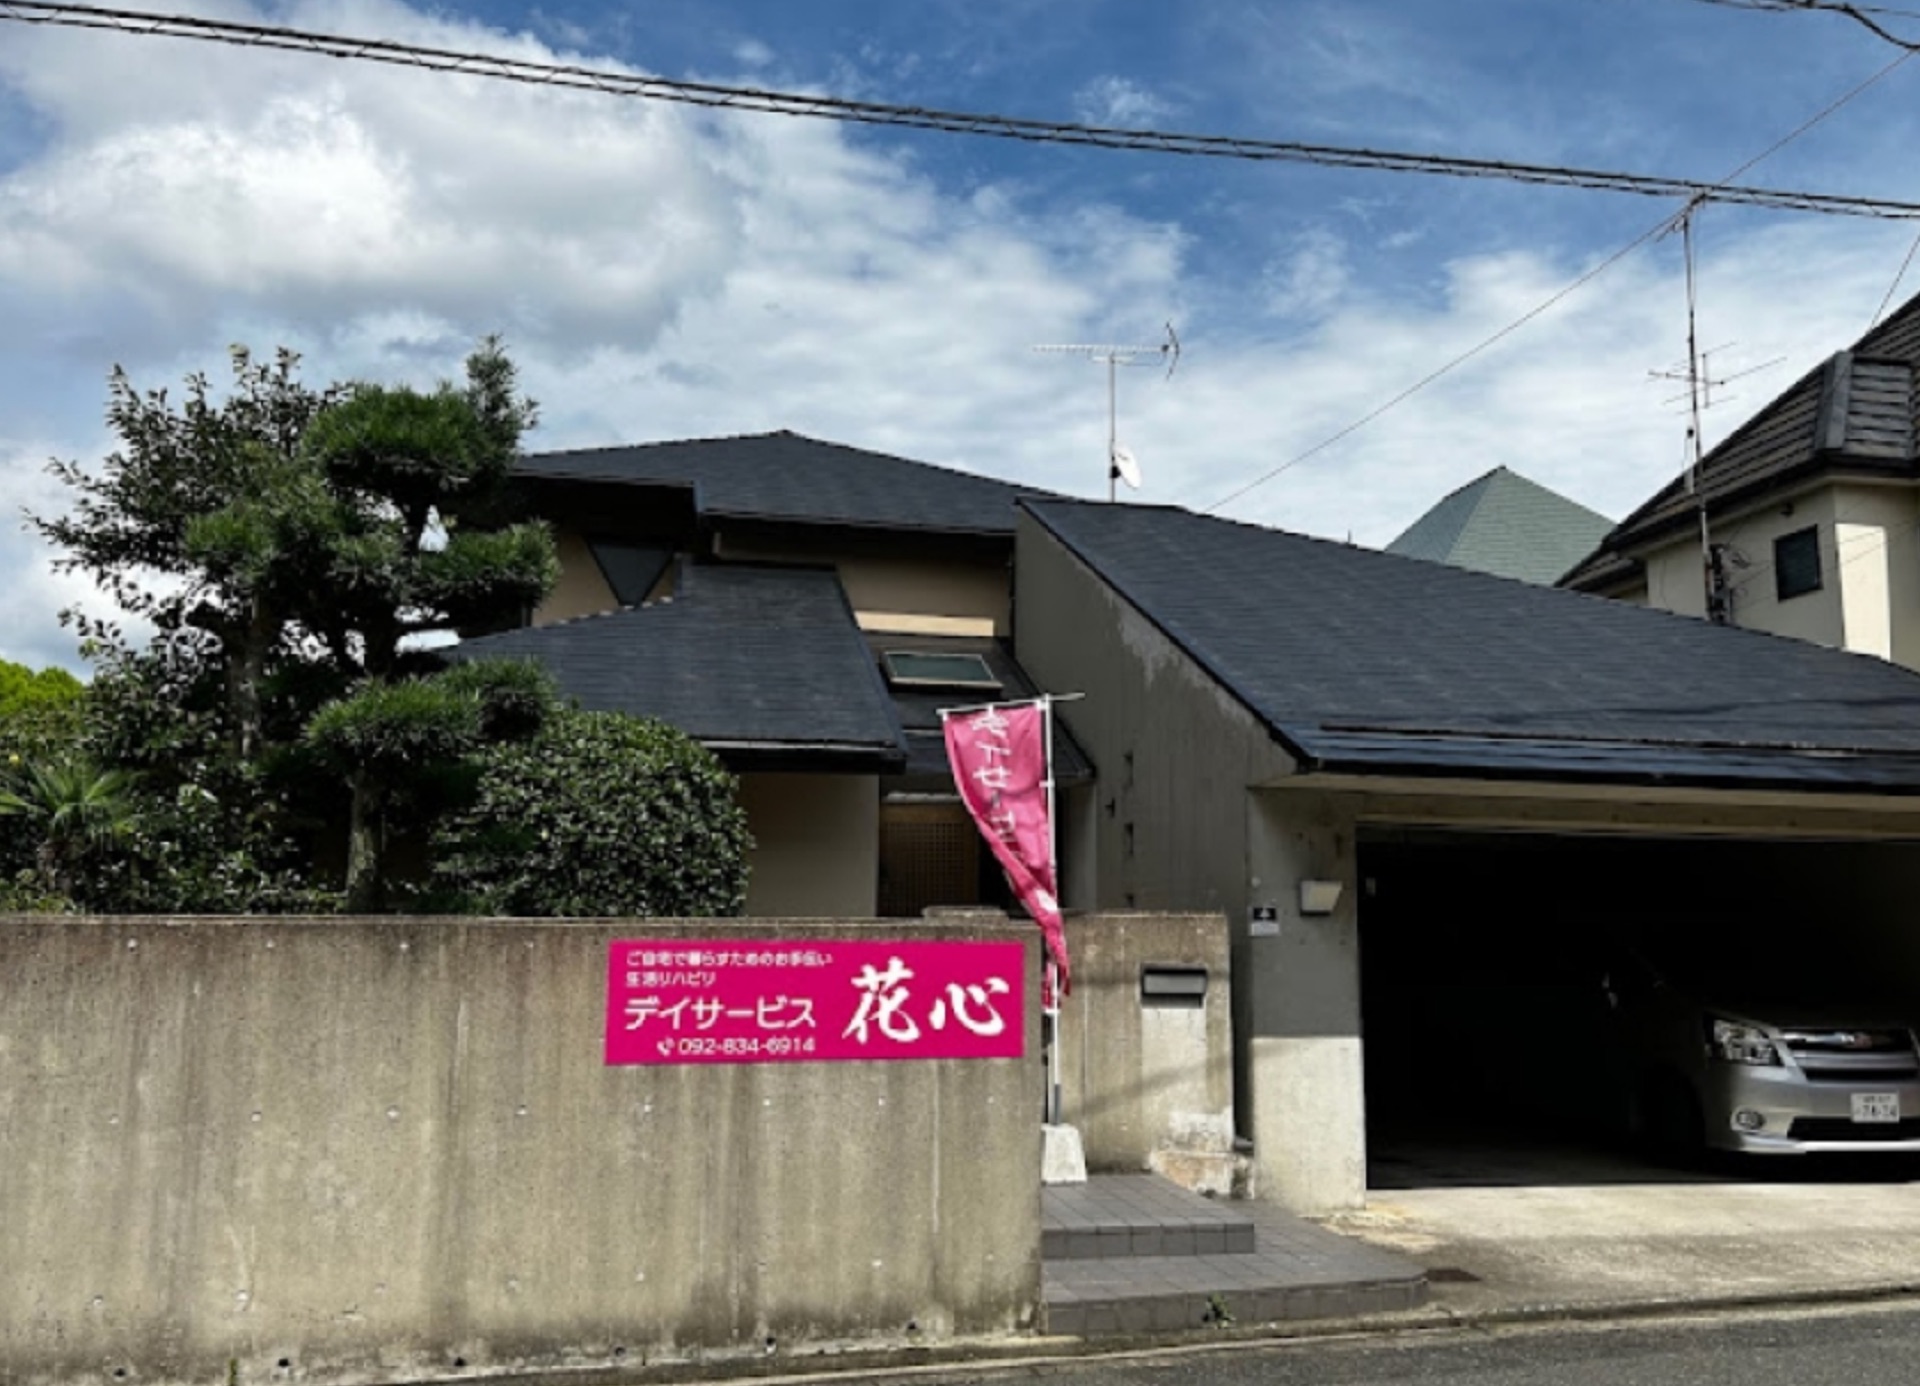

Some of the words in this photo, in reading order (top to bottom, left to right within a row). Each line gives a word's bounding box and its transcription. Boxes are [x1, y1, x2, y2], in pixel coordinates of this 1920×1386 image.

[624, 995, 816, 1030] デイサービス
[842, 956, 1010, 1045] 花心
[678, 1036, 815, 1055] 092-834-6914
